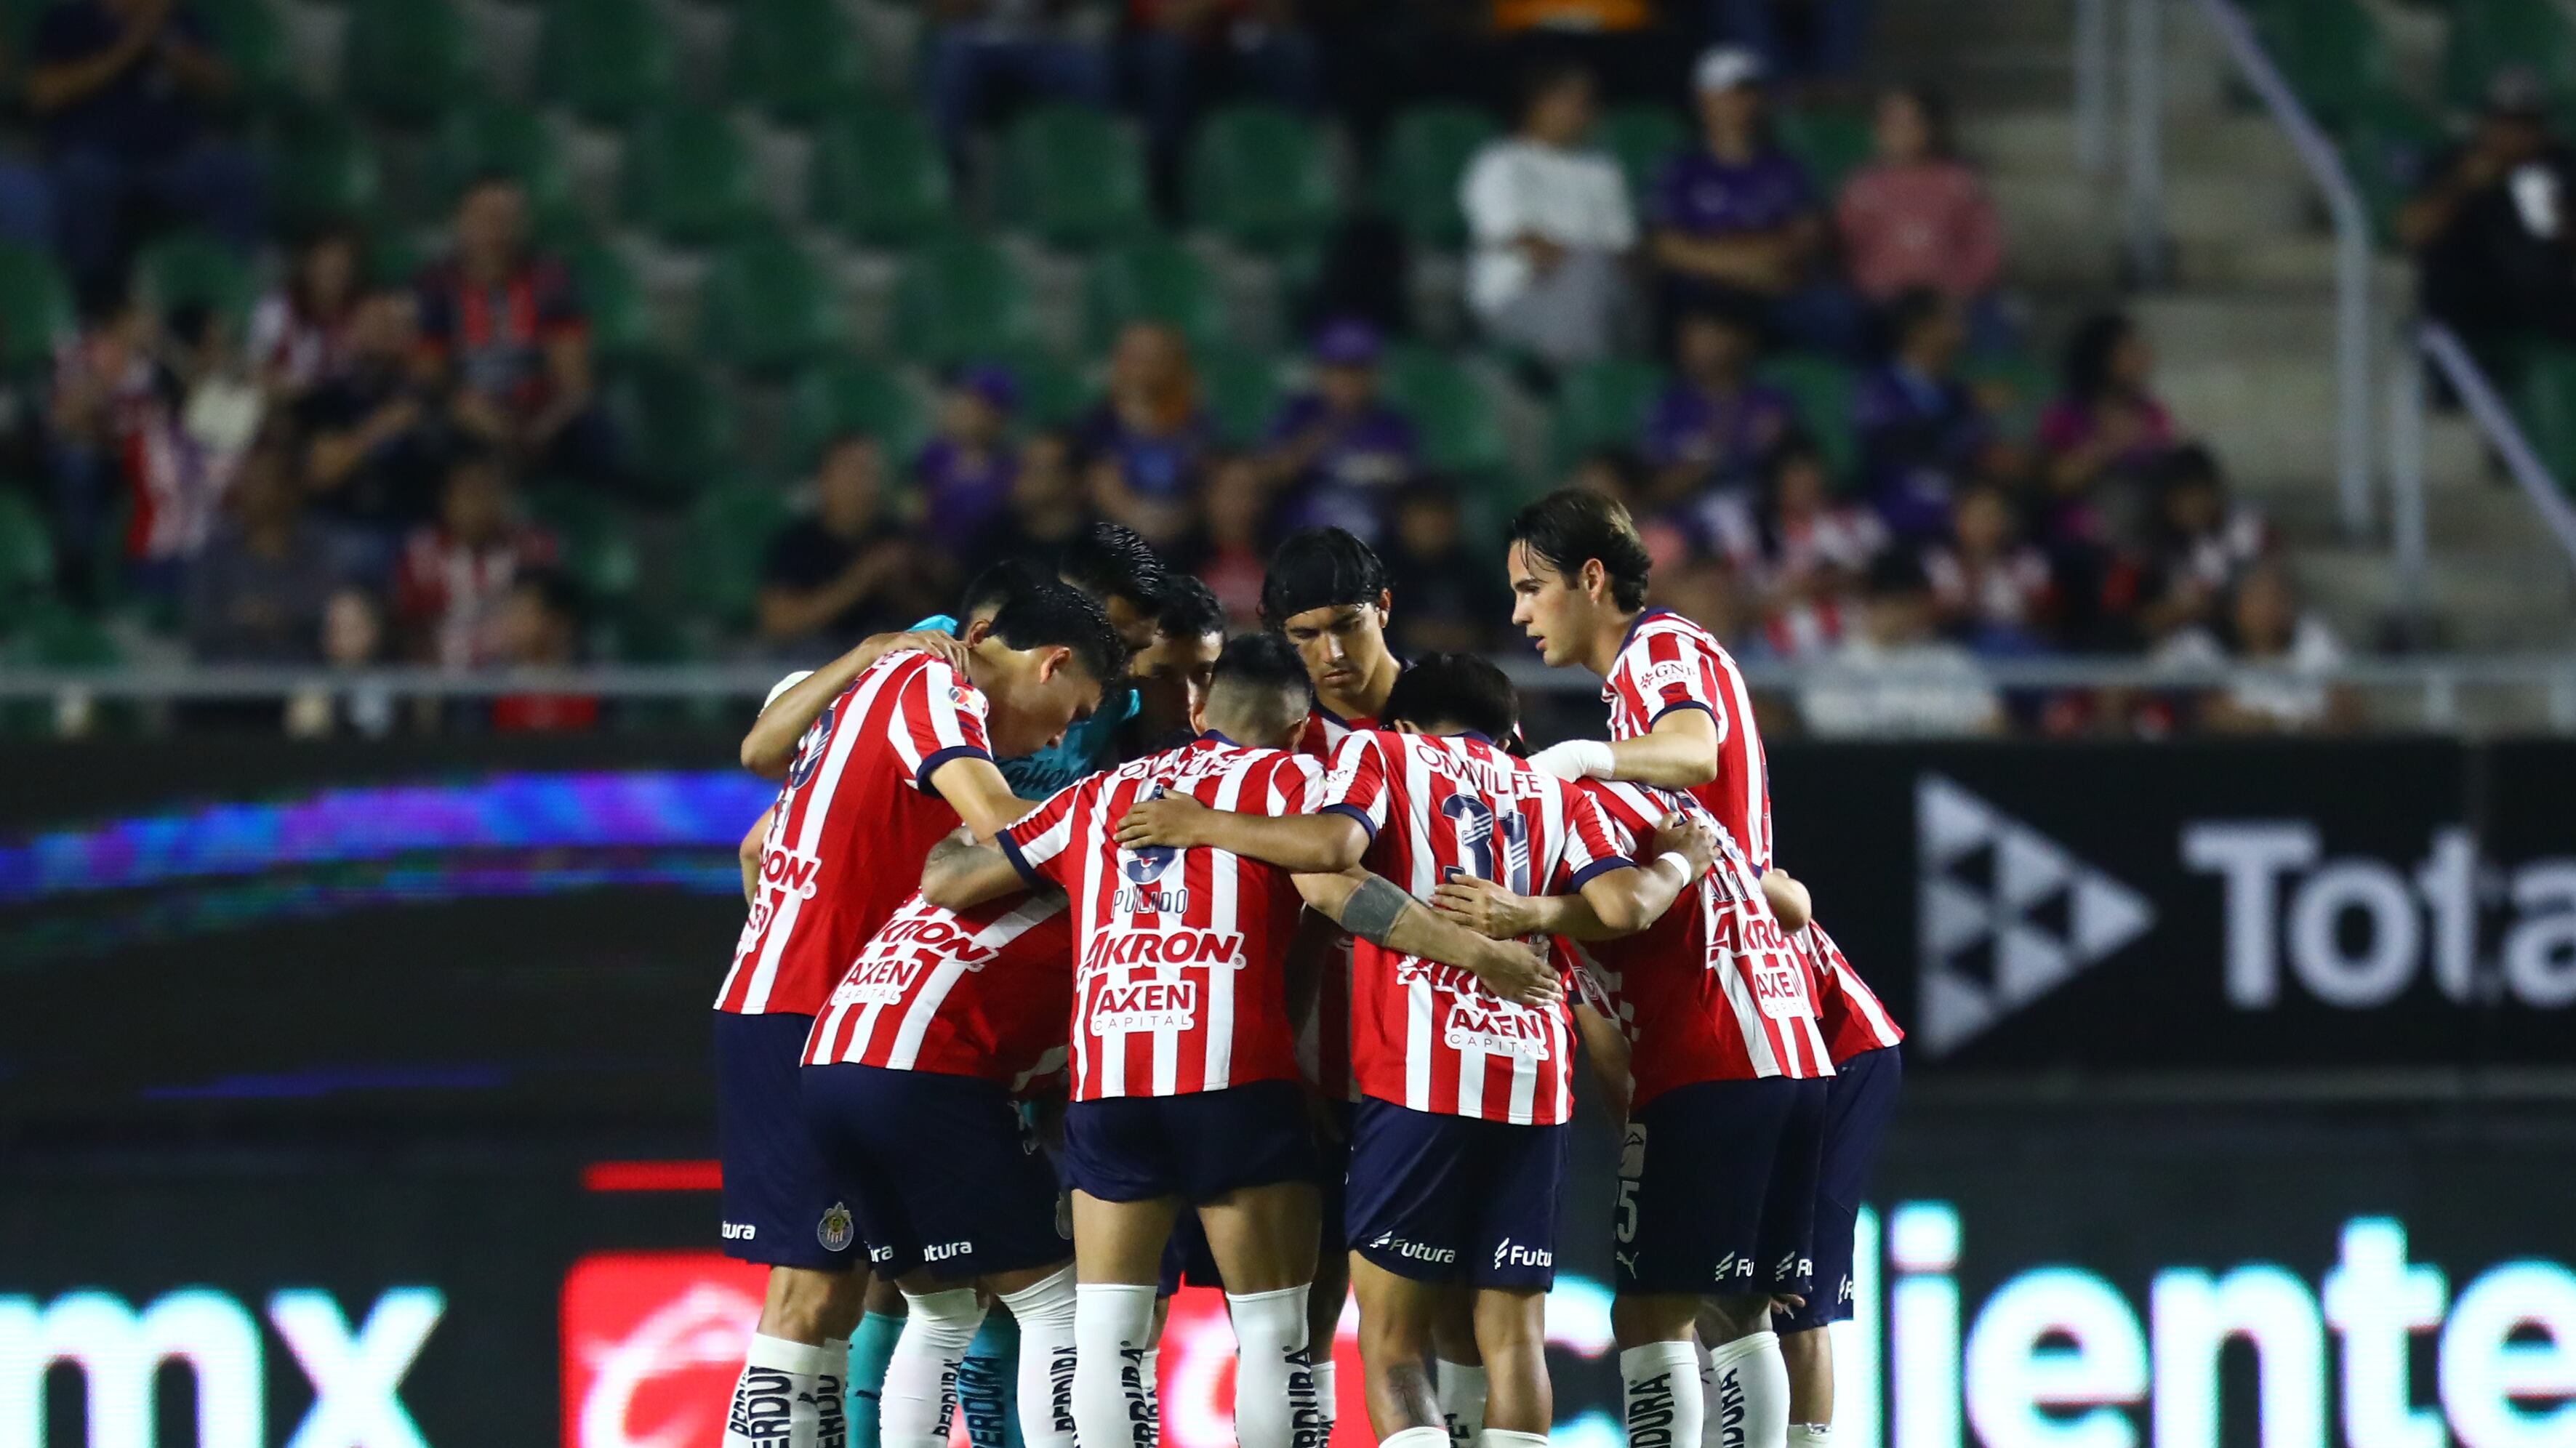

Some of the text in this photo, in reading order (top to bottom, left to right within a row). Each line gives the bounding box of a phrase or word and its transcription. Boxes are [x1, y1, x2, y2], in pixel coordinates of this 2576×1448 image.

[1112, 888, 1189, 918] PULIDO
[2181, 817, 2576, 1010] Tota
[1079, 930, 1239, 974] AKRON
[843, 960, 912, 987] AXEN
[1096, 984, 1189, 1015] AXEN
[1094, 1015, 1189, 1031] CAPITAL
[1451, 1008, 1541, 1039] AXEN
[1450, 1033, 1545, 1055] CAPITAL
[1389, 1238, 1456, 1264] Futura
[0, 1285, 446, 1448] mx
